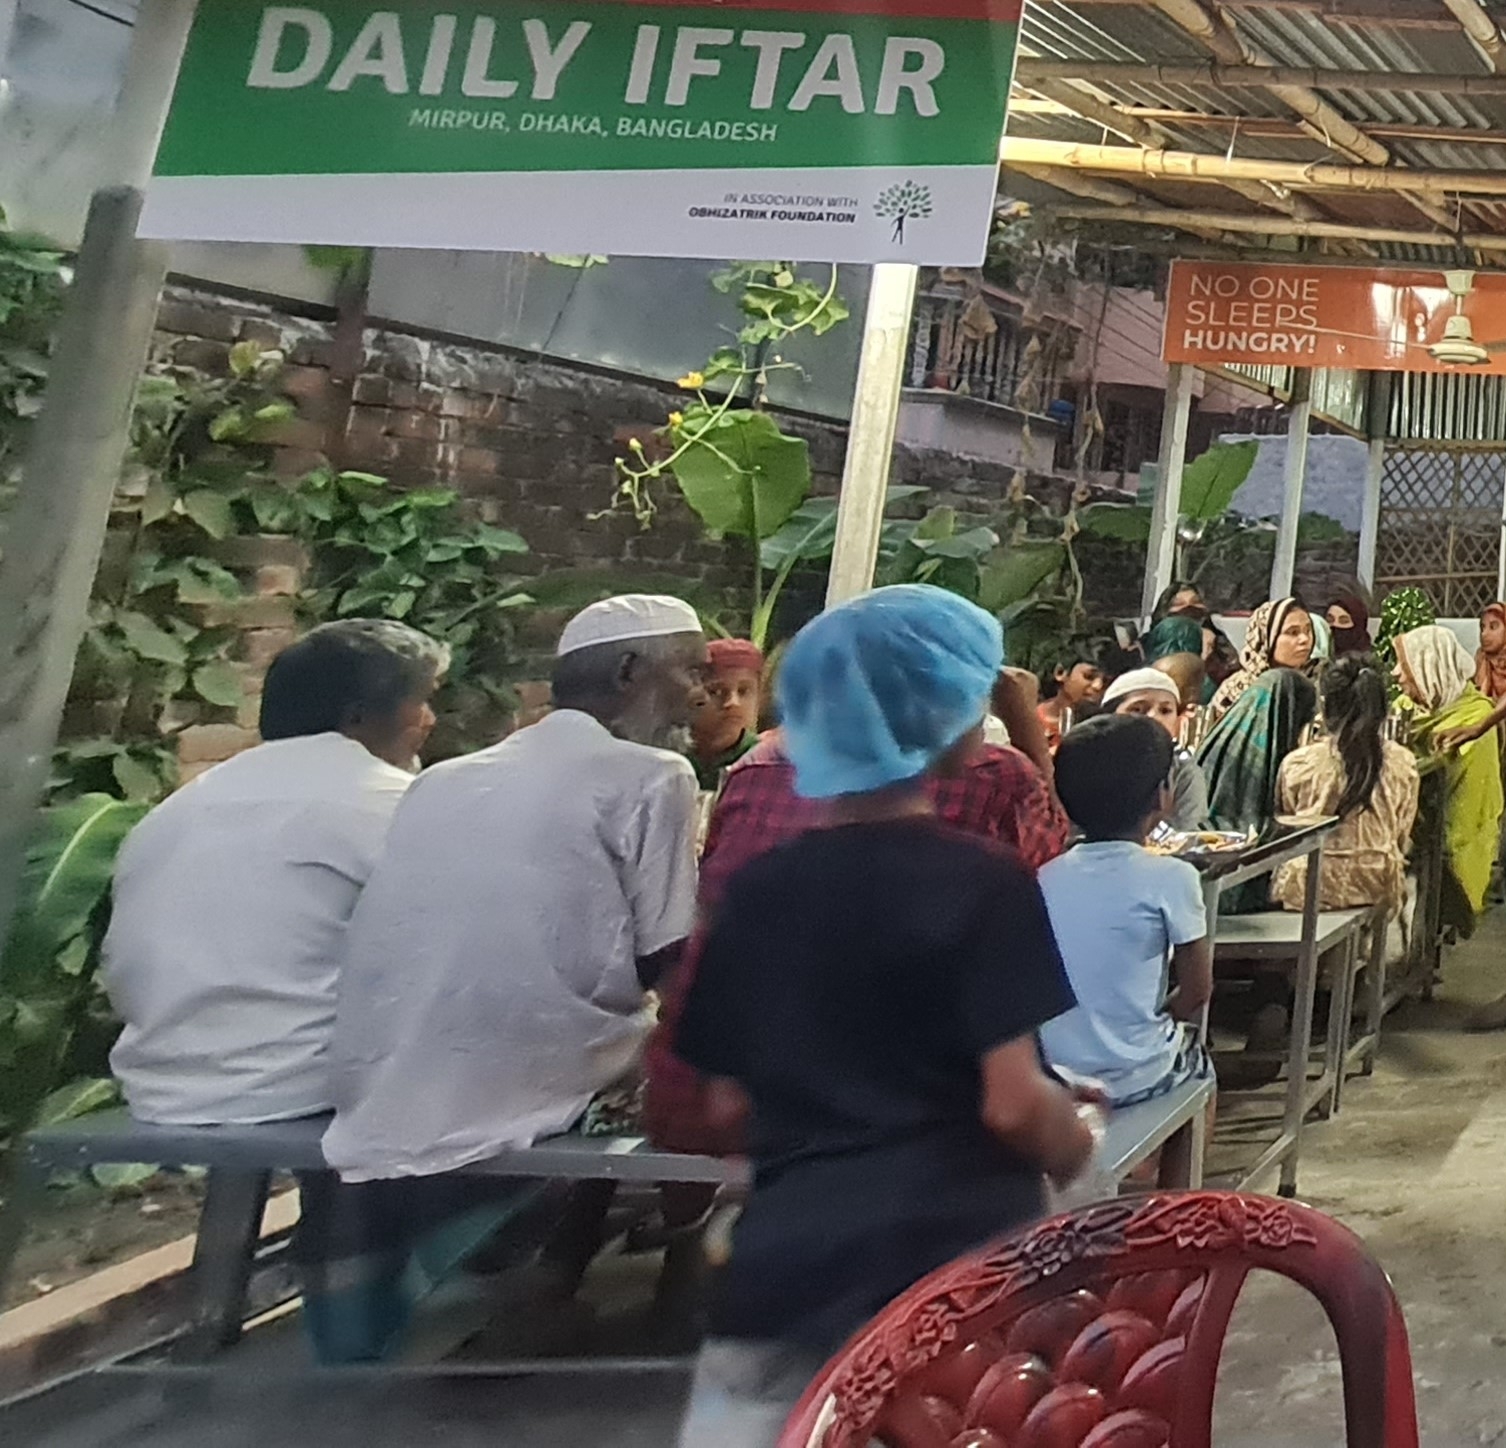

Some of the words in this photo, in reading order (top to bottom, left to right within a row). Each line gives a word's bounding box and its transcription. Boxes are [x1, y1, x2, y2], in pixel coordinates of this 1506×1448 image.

[246, 7, 593, 100] DAILY
[624, 24, 946, 118] IFTAR
[408, 108, 511, 133] MIRPUR,
[519, 113, 609, 137] DHAKA,
[616, 117, 778, 142] BANGLADESH
[740, 194, 824, 207] ASSOCIATION
[827, 197, 859, 208] WITH
[688, 207, 767, 220] OBHIZATRIK
[770, 210, 856, 223] FOUNDATION
[1190, 274, 1240, 297] NO
[1249, 276, 1320, 302] ONE
[1185, 301, 1318, 328] SLEEPS
[1183, 329, 1316, 354] HUNGRY!
